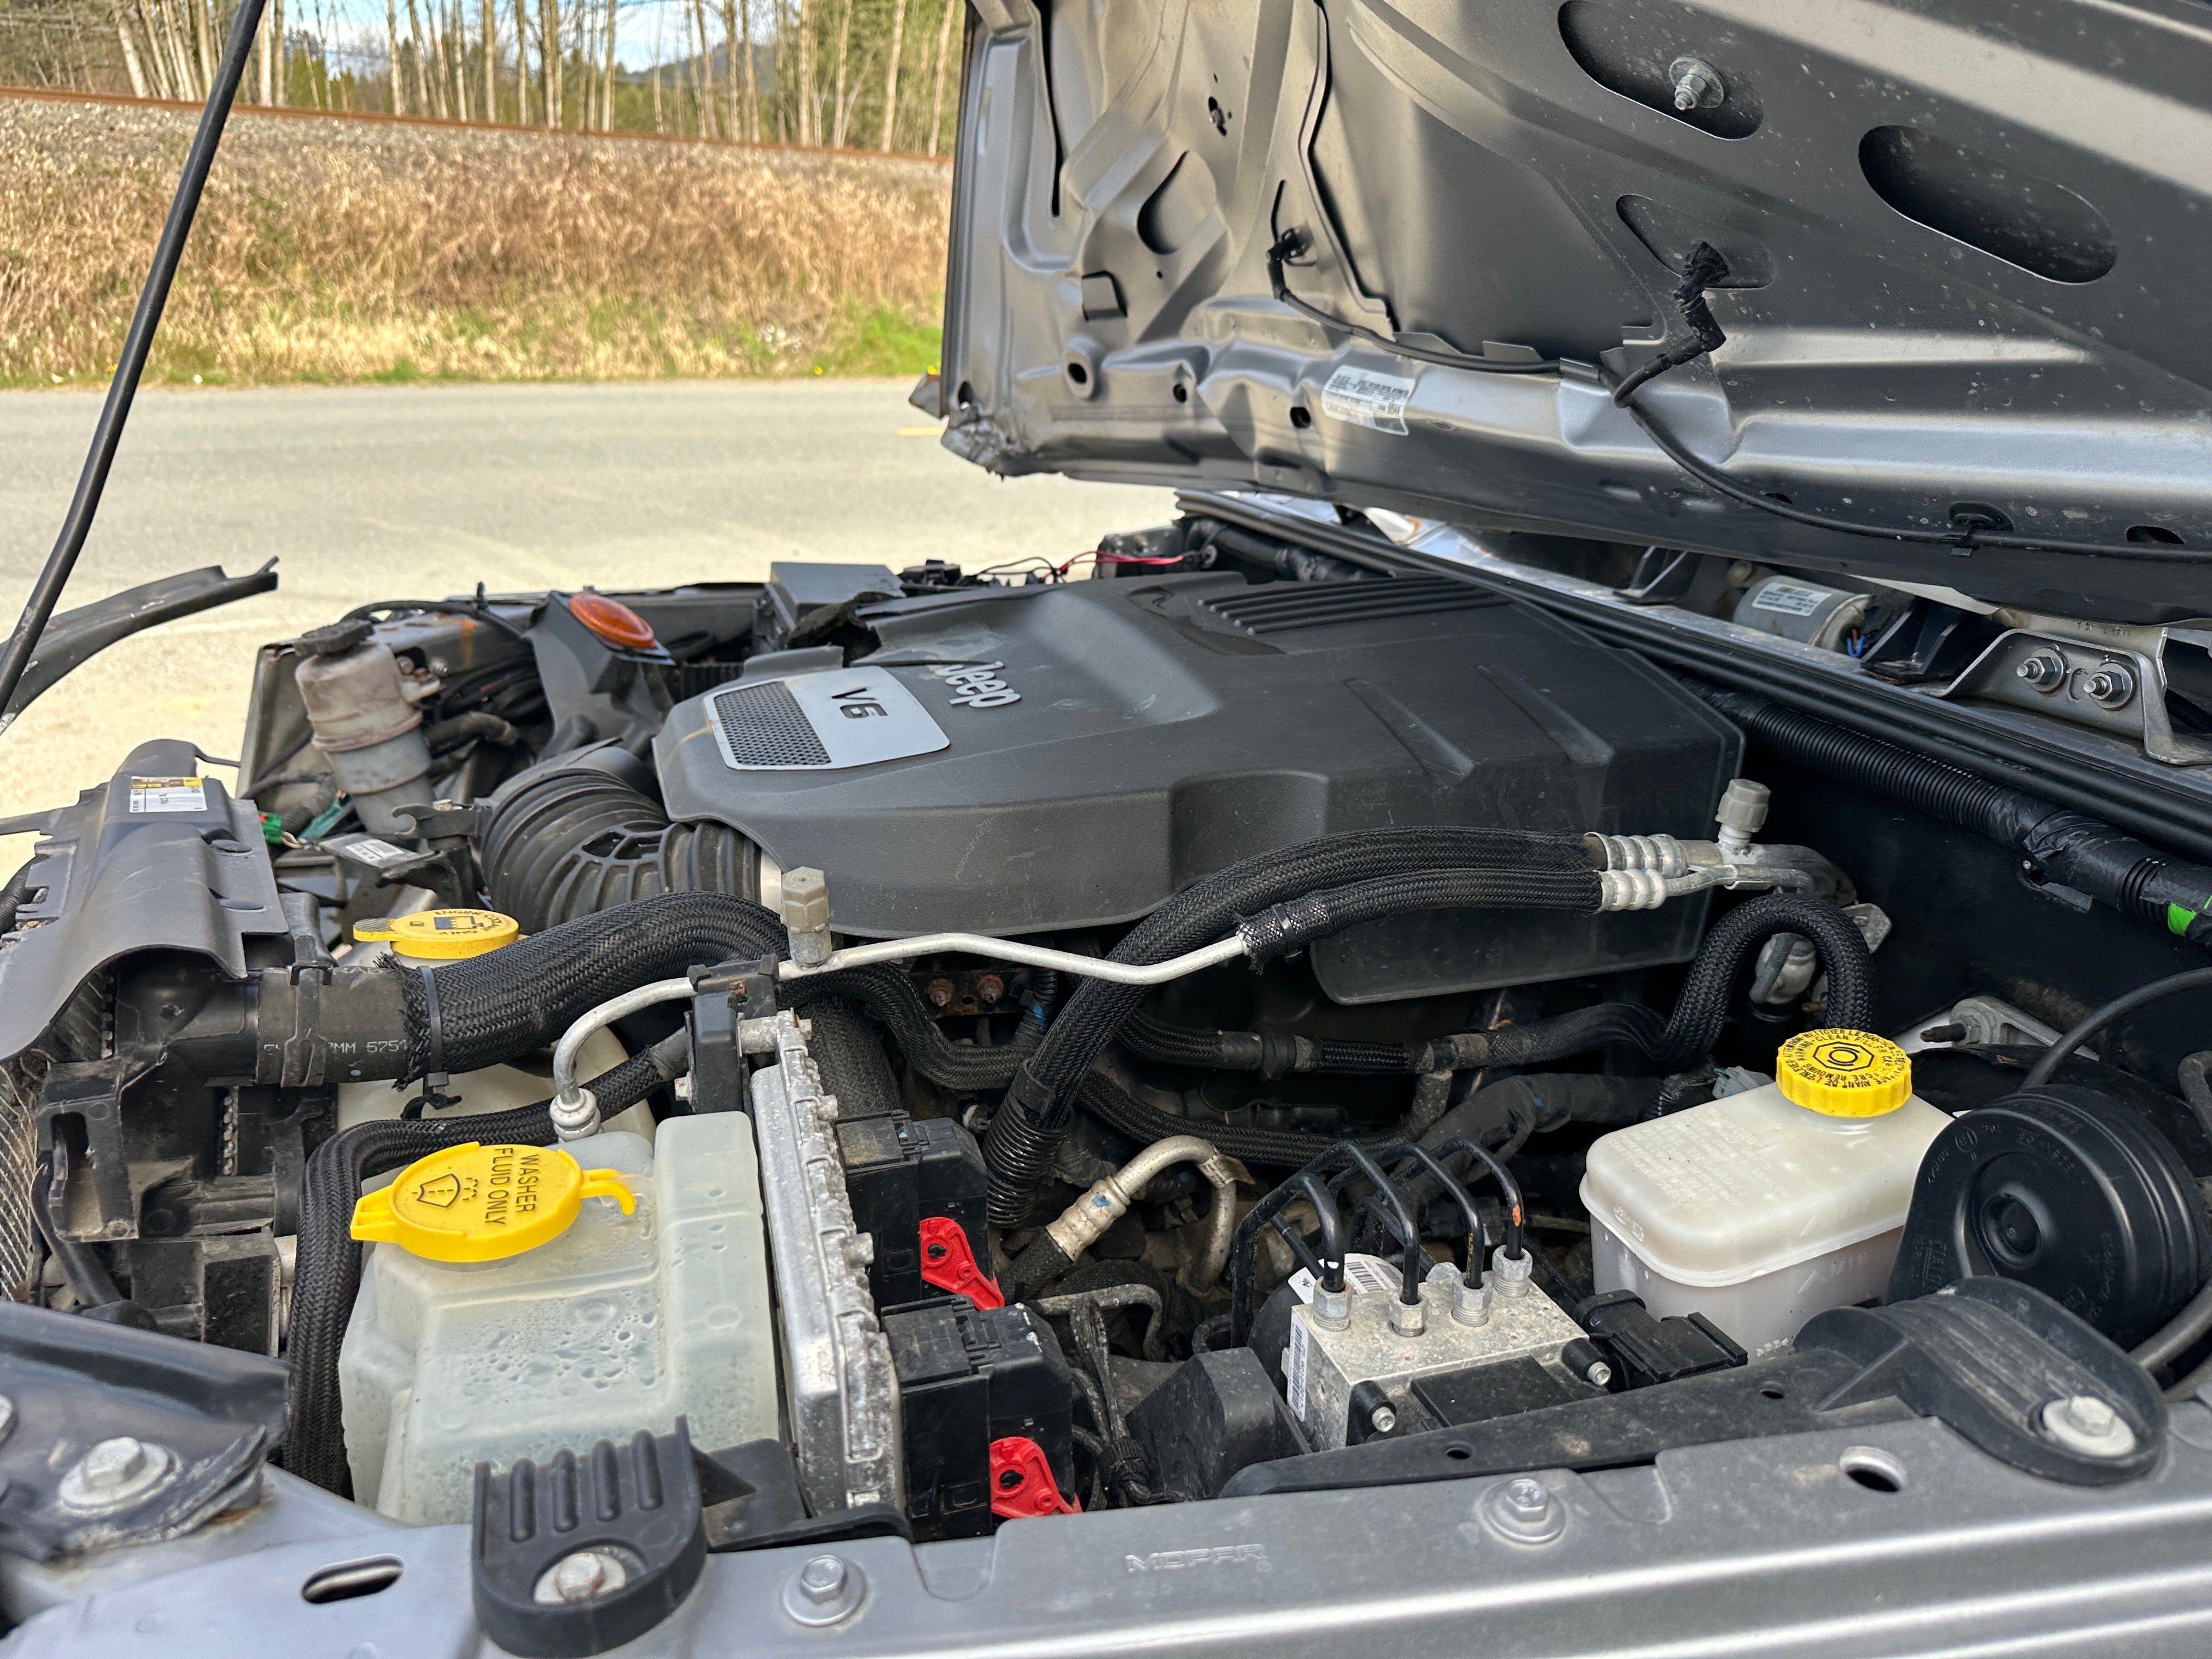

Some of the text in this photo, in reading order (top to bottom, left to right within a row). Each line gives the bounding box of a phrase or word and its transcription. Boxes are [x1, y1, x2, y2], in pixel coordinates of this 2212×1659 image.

[935, 661, 1022, 709] Jeep
[831, 687, 888, 719] V6
[1802, 1063, 1847, 1081] REMOVING
[1842, 1080, 1871, 1088] AVANT
[484, 1147, 513, 1225] FLUID ONLY
[516, 1154, 540, 1213] WASHER
[1124, 1543, 1268, 1573] MOPAR
